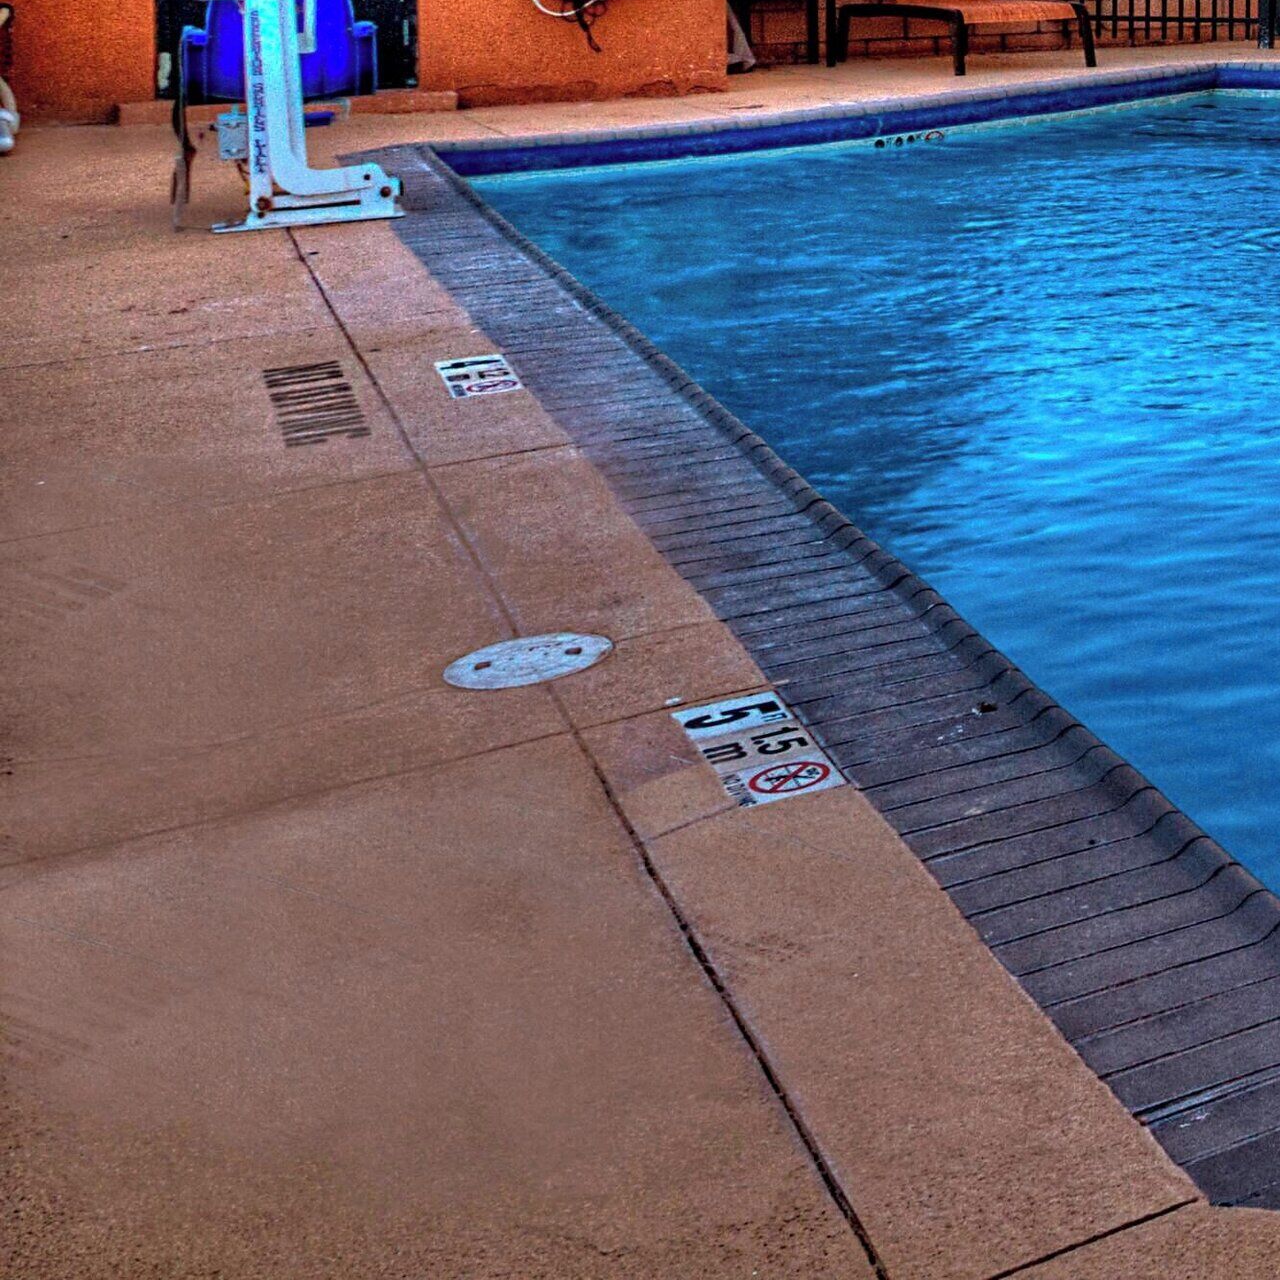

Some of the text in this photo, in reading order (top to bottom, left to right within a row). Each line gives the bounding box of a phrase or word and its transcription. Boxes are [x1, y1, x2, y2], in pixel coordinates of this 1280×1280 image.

[684, 701, 781, 730] 5
[703, 742, 748, 765] m
[750, 726, 809, 755] 1.5
